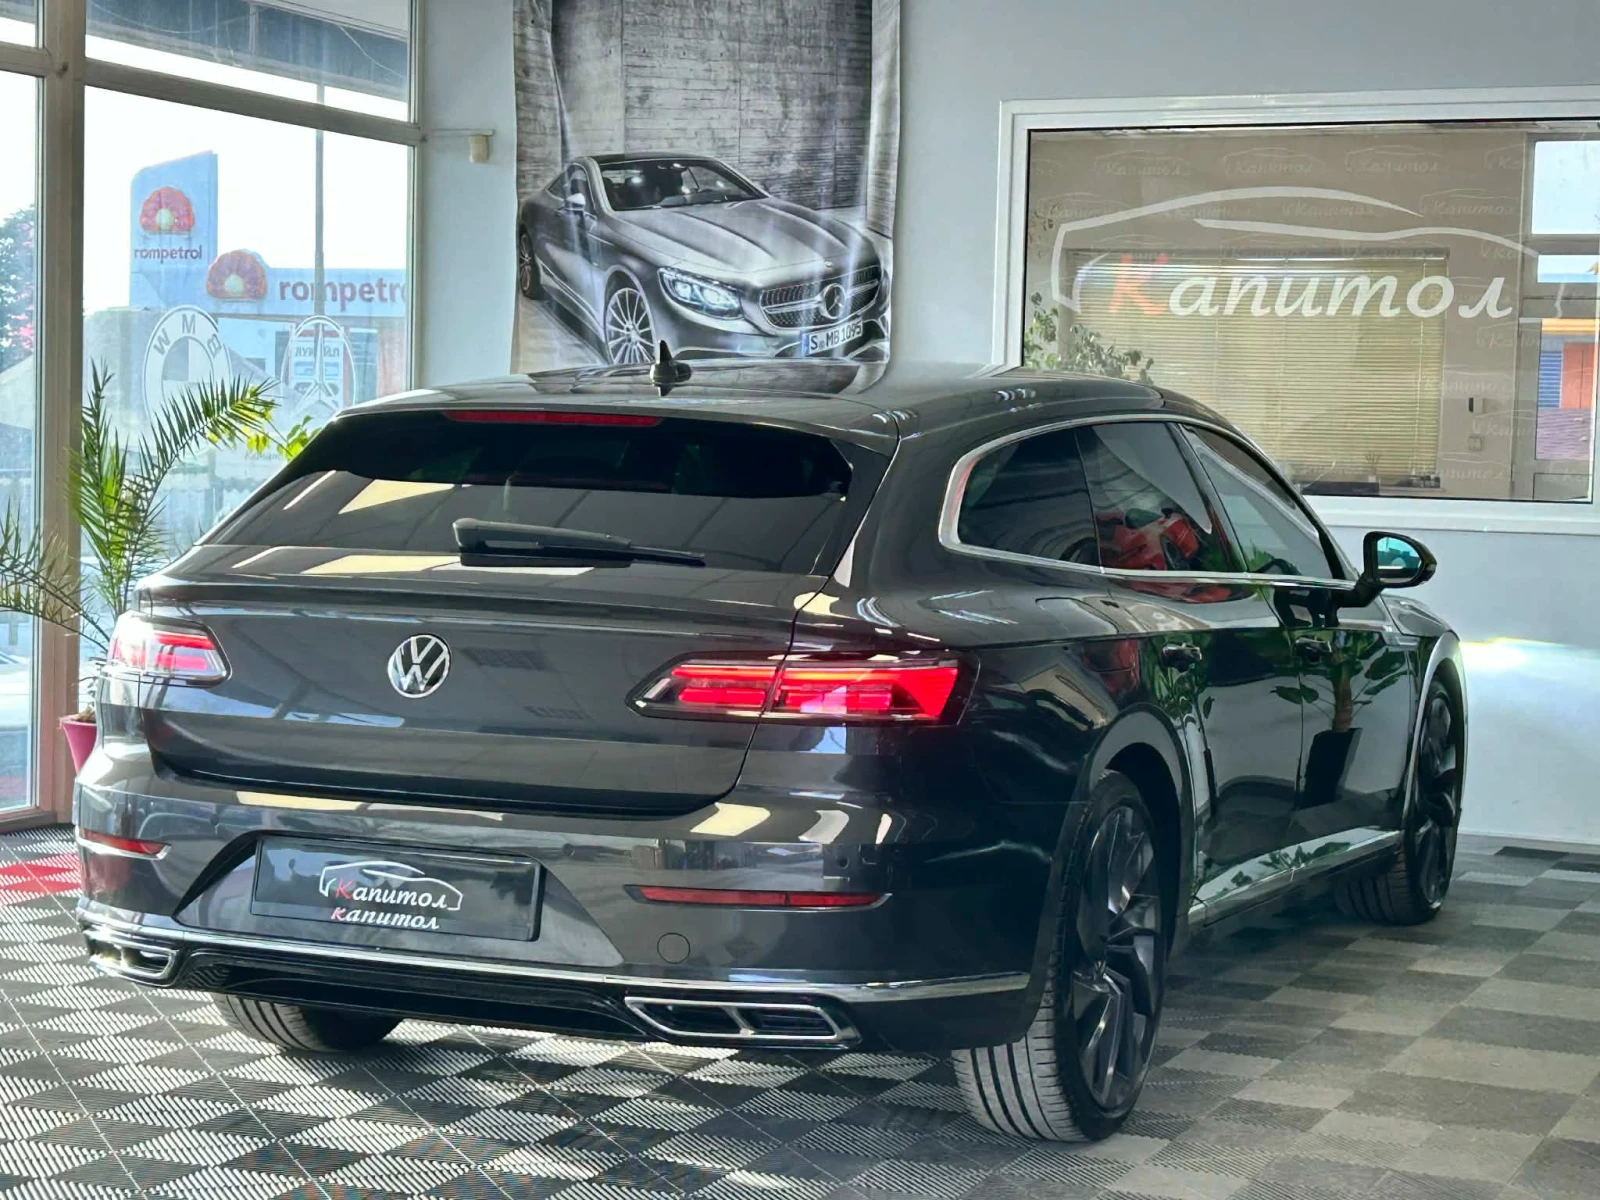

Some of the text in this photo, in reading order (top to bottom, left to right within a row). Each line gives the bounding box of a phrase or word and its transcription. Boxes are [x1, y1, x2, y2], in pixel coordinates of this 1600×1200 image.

[133, 244, 202, 265] rompetrol
[1107, 252, 1512, 318] Капитол
[295, 345, 340, 357] ЛУКЙЛ
[810, 334, 819, 351] S
[334, 877, 448, 909] Капитол
